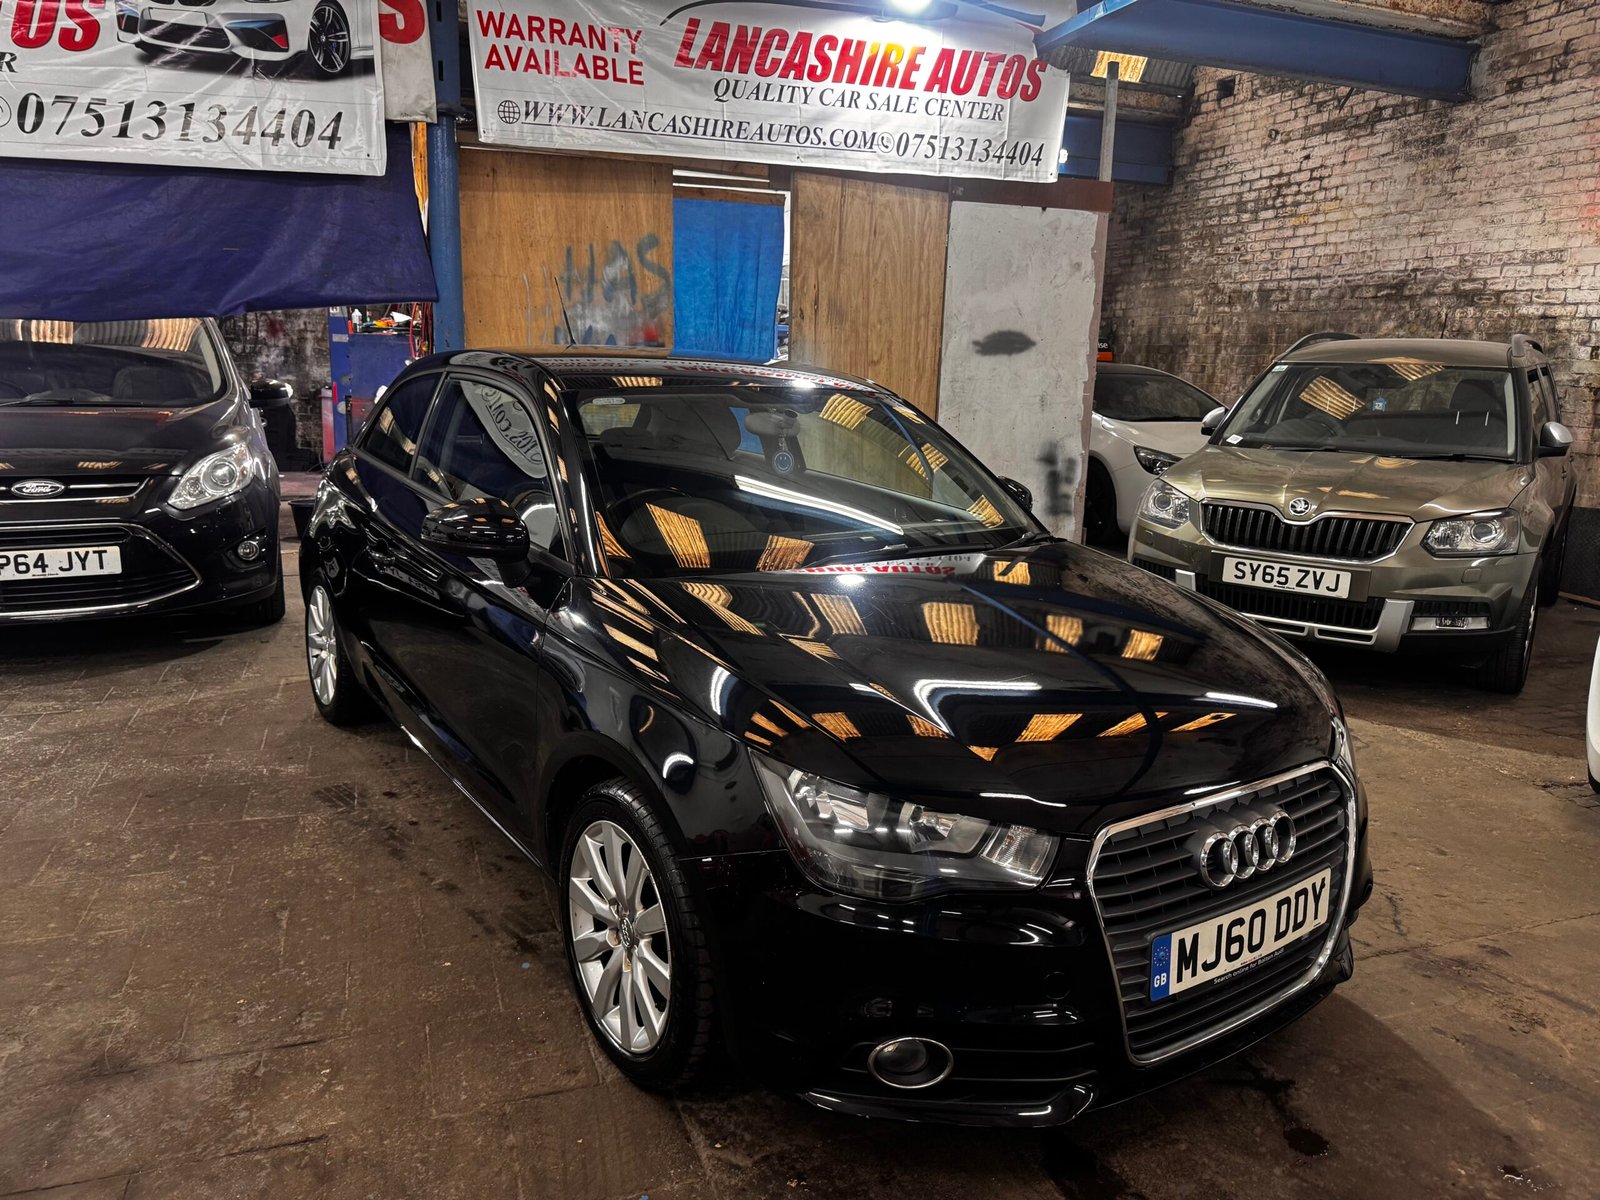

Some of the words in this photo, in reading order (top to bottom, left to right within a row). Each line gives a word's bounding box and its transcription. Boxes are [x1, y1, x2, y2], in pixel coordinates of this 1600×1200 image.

[0, 0, 101, 52] OS
[476, 10, 643, 55] WARRANTY
[484, 43, 645, 86] AVAILABLE
[674, 18, 926, 90] LANCASHIRE
[924, 48, 1047, 102] AUTOS
[17, 92, 342, 150] 07513134404
[713, 77, 812, 105] QUALITY
[819, 88, 860, 110] CAR
[866, 92, 917, 115] SALE
[925, 98, 1005, 122] CENTER
[523, 100, 877, 151] WWW.LANCASHIREAUTOS.COM
[896, 131, 1044, 167] 07513134404
[22, 482, 54, 493] Ford
[58, 549, 108, 572] JYT
[1234, 561, 1291, 585] SY65
[1295, 568, 1341, 592] ZVJ
[1176, 908, 1267, 985] MJ60
[1274, 877, 1326, 943] DDY
[1153, 972, 1167, 988] GB
[1213, 973, 1233, 985] Search
[1232, 966, 1249, 977] online
